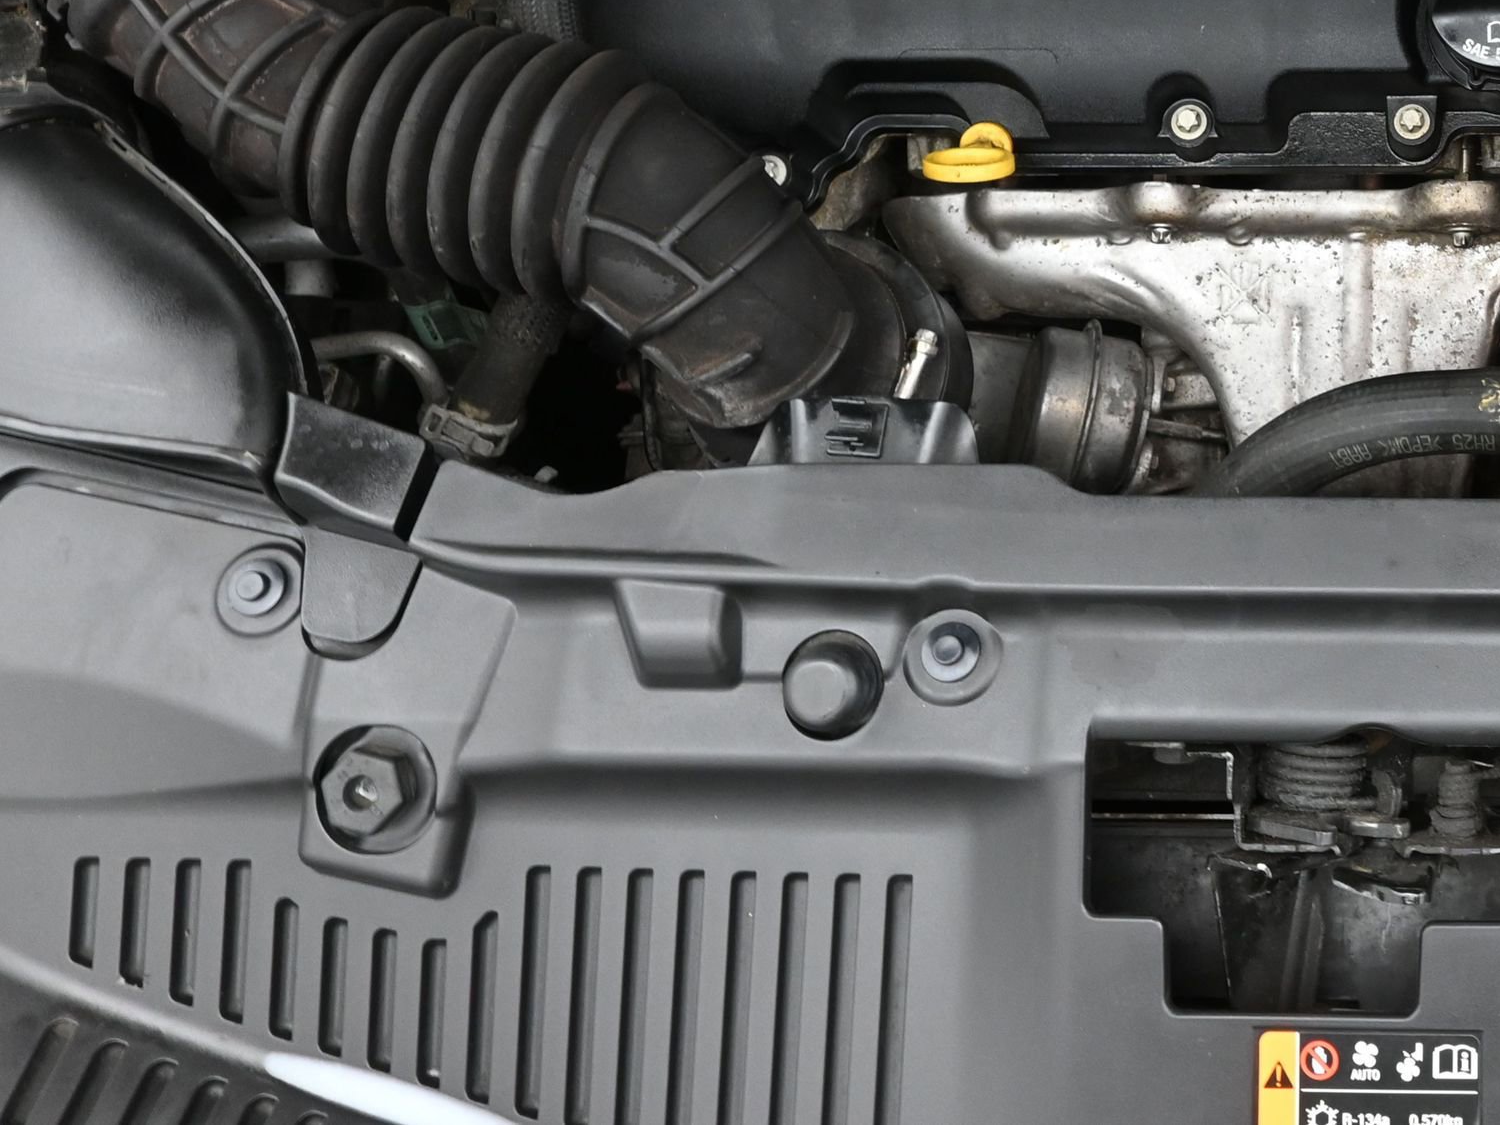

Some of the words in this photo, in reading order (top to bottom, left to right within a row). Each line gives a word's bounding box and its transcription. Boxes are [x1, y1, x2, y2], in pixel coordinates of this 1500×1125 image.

[1462, 38, 1490, 59] SAE
[1451, 433, 1496, 452] RH25
[1350, 1068, 1381, 1082] AUTO
[1341, 1112, 1391, 1125] R-134a
